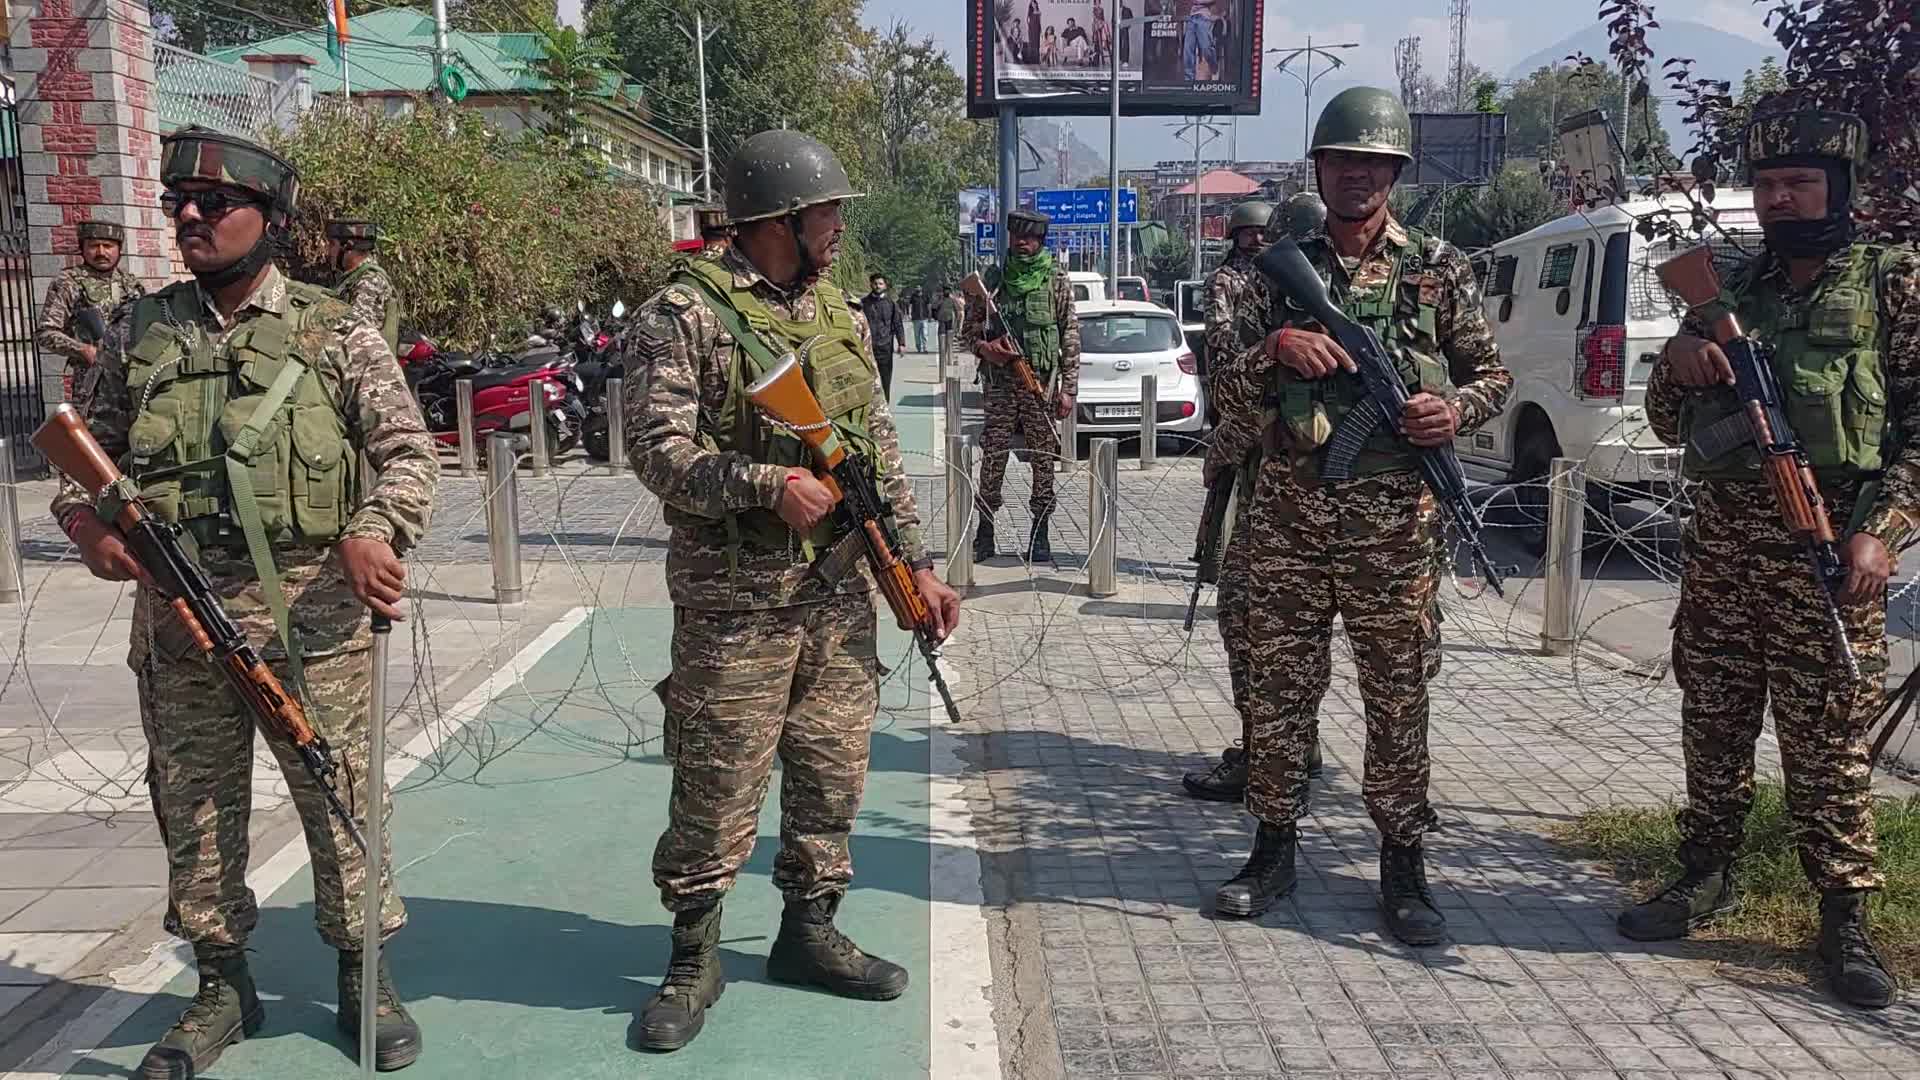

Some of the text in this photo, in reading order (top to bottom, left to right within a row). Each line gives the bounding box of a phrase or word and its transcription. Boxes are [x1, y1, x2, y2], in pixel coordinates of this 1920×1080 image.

[1151, 22, 1178, 30] GREAT
[1193, 84, 1236, 92] KAPSONS
[983, 224, 993, 237] P
